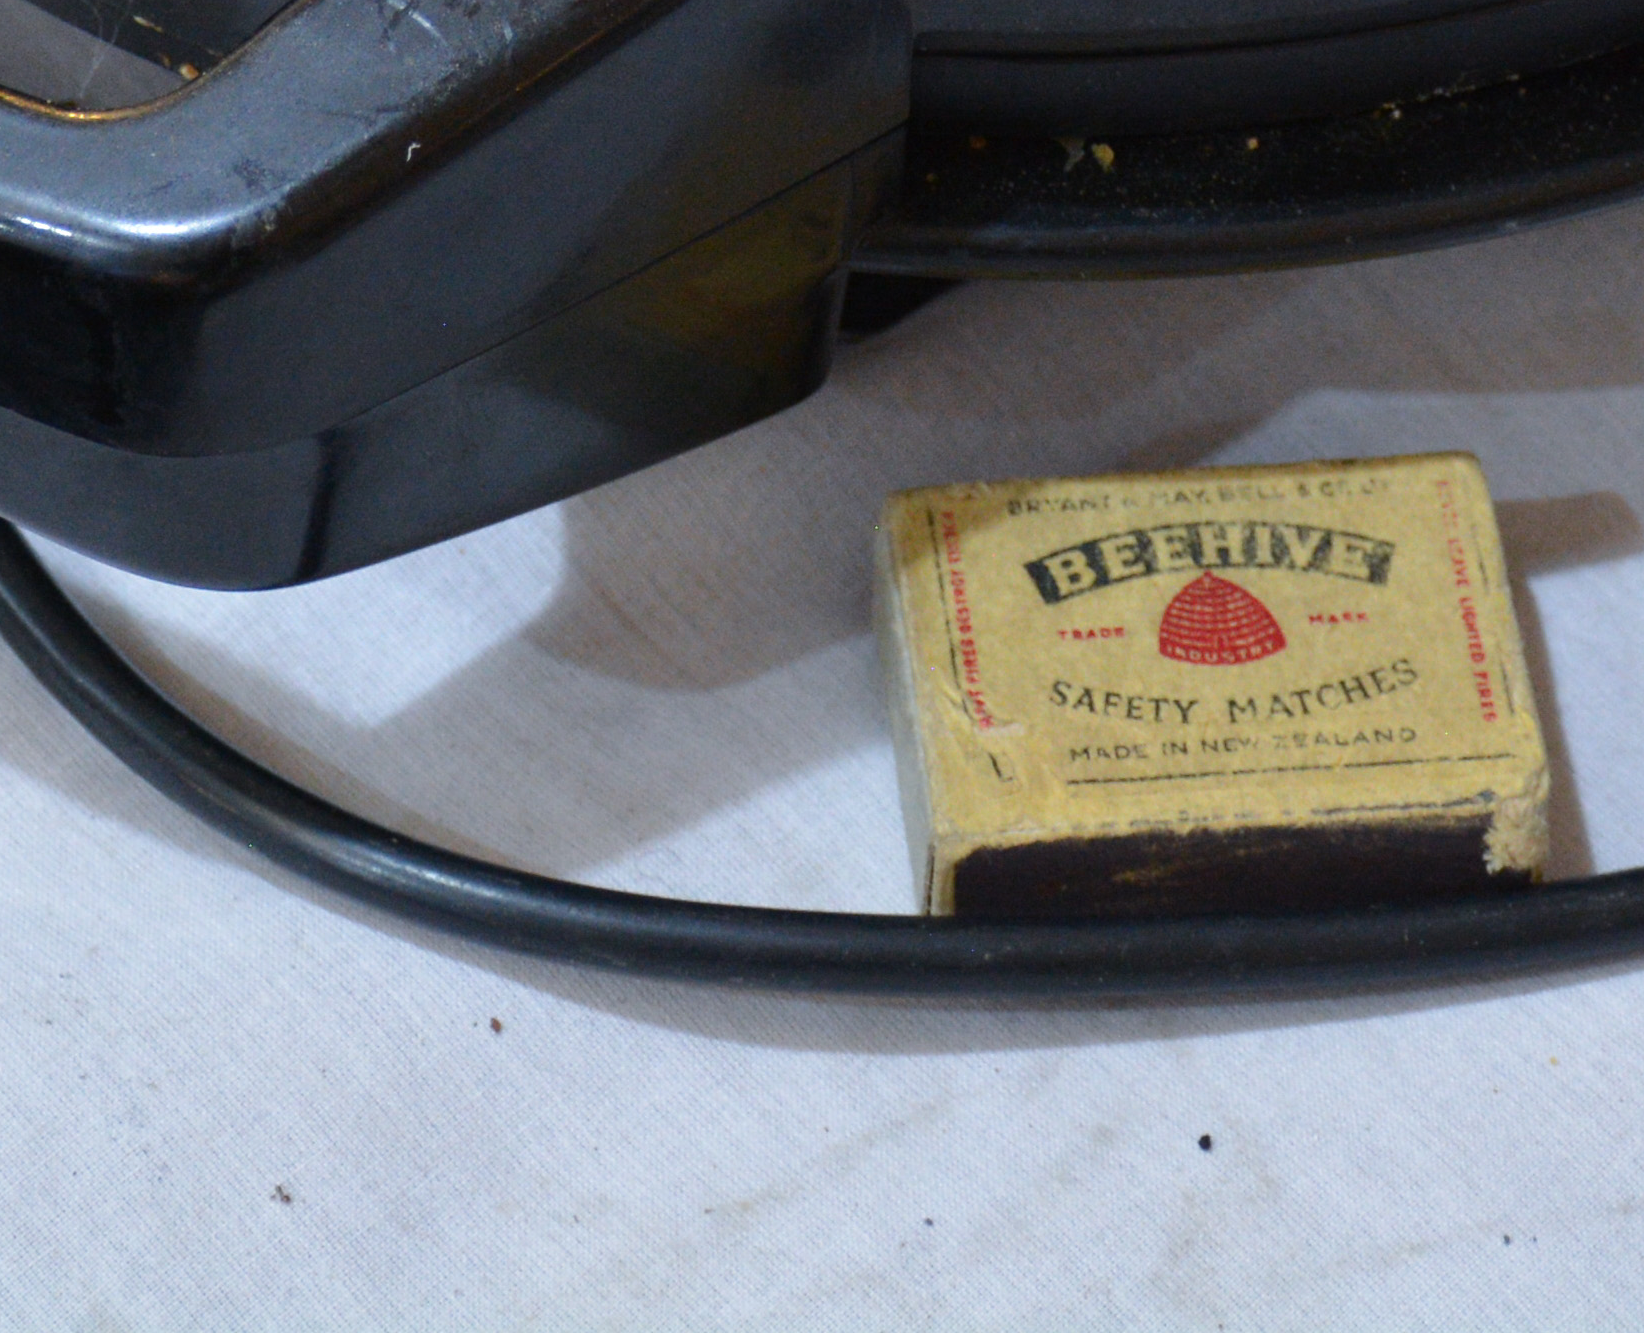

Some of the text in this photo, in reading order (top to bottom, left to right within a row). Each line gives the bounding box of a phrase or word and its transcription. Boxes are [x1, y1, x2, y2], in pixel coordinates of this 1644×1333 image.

[1041, 521, 1377, 597] BEEHIVE
[1057, 610, 1369, 641] TRADE MARK
[1165, 638, 1277, 665] INDUSTRY
[1458, 595, 1486, 665] LIGHTED
[1472, 670, 1498, 724] FIRES
[1048, 656, 1420, 725] SAFETY MATCHES
[1068, 726, 1419, 763] MADE IN NEW ZEALAND
